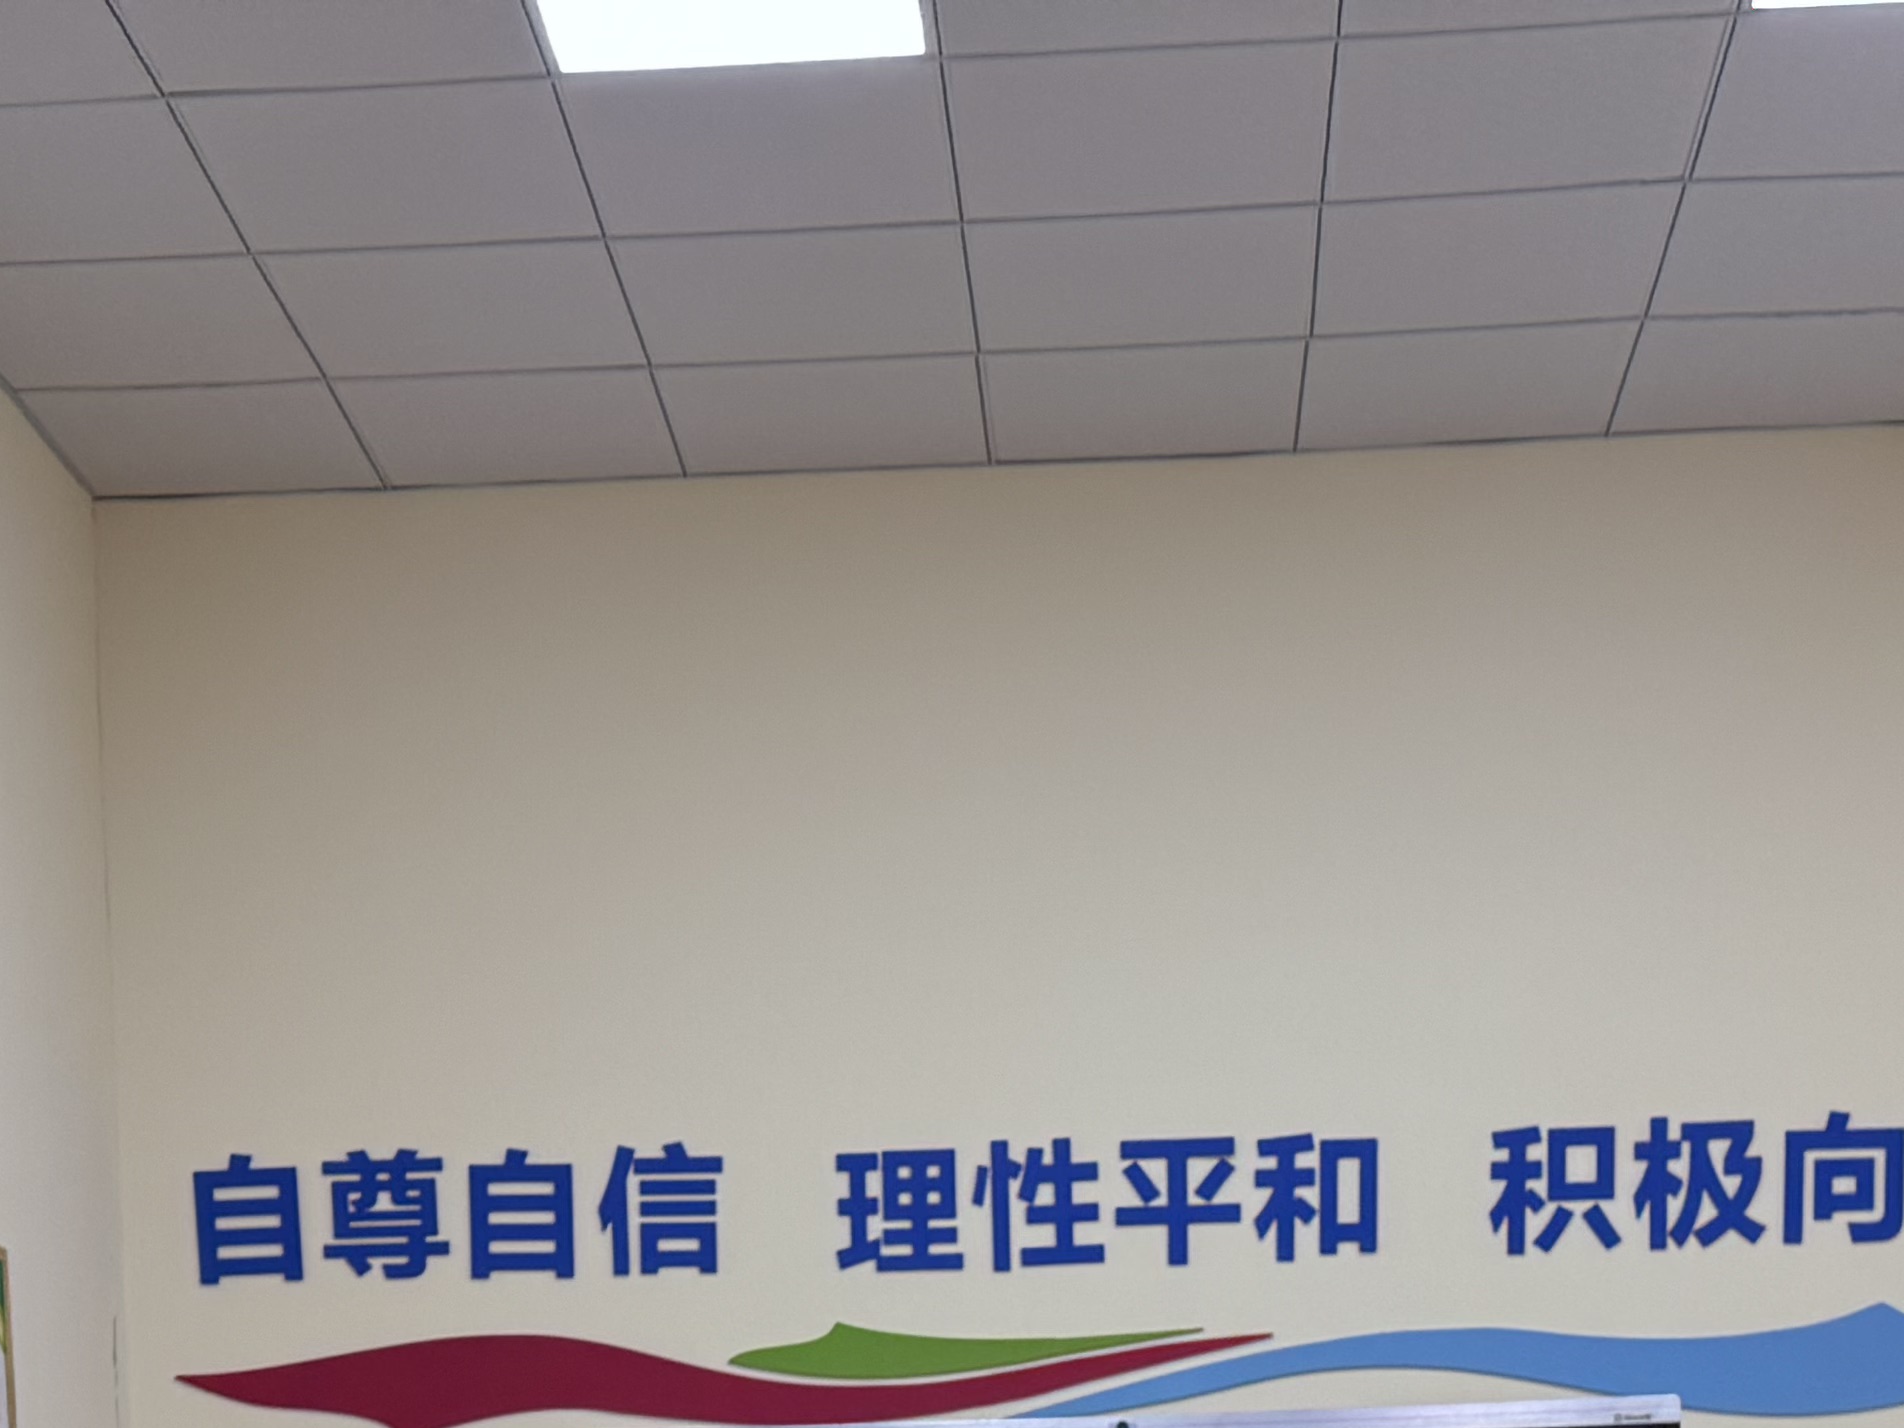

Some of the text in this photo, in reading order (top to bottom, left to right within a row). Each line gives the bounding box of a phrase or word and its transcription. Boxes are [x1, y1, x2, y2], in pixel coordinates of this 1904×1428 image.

[192, 1142, 724, 1285] 自尊自信
[835, 1133, 1378, 1272] 理性平和
